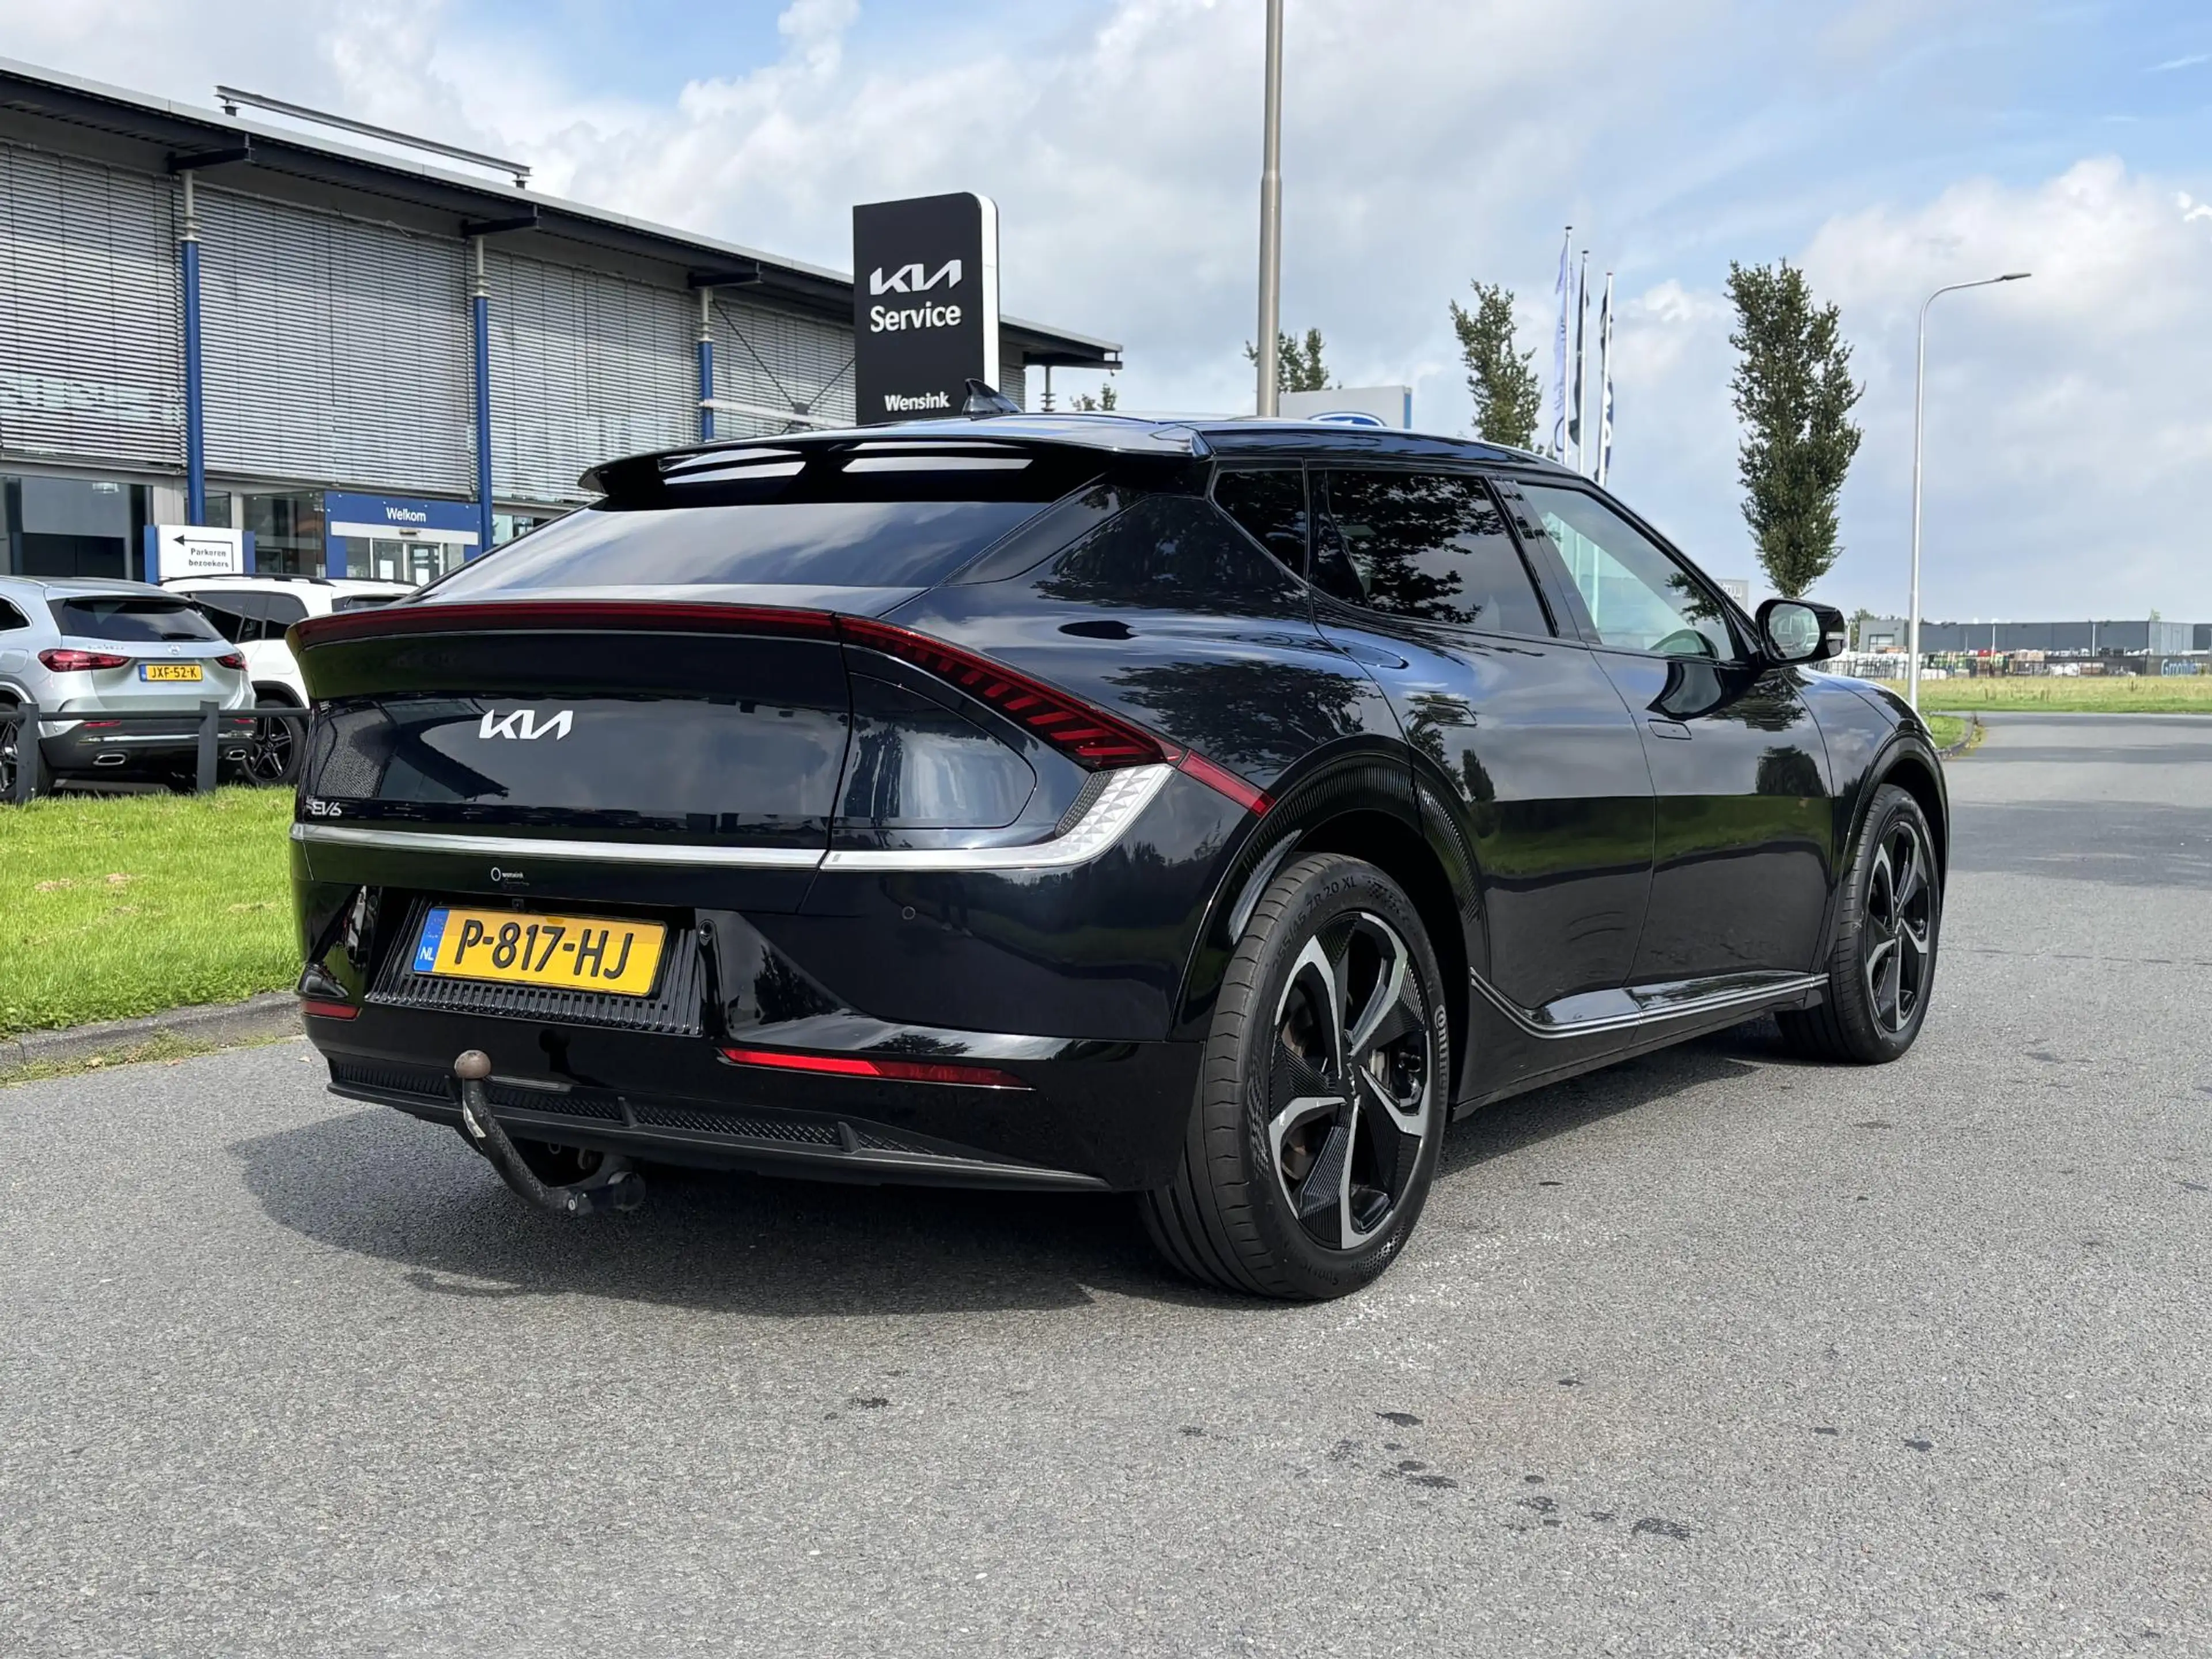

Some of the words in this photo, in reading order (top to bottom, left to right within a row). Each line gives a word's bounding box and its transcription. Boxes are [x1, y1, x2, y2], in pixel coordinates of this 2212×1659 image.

[869, 259, 962, 295] KIA
[870, 301, 961, 332] Service
[884, 391, 951, 412] Wensink
[386, 507, 426, 522] Welkom
[191, 547, 226, 557] Parkeren
[188, 559, 229, 568] bezoekers
[151, 666, 197, 678] JXF-52-K
[479, 709, 573, 741] KIA
[312, 801, 342, 816] EV6
[1323, 881, 1339, 898] 20
[1341, 876, 1358, 890] XL
[420, 946, 434, 962] NL
[454, 919, 634, 979] P-817-HJ
